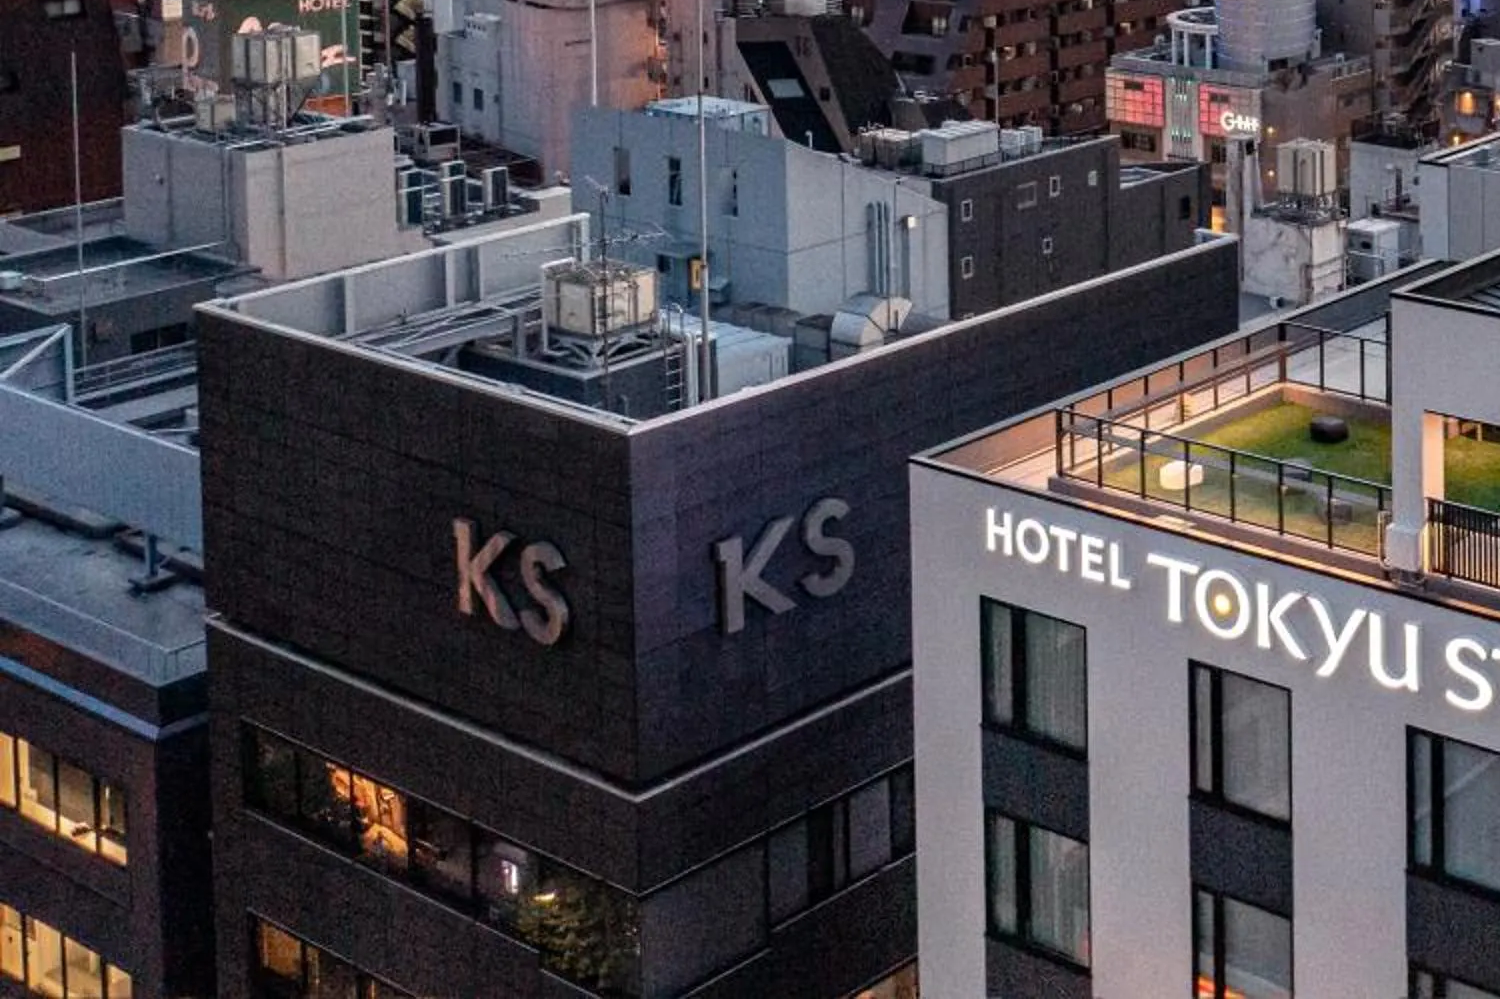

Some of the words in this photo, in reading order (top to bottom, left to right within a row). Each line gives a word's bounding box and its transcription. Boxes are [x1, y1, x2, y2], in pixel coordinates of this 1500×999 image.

[453, 517, 569, 647] KS
[713, 497, 857, 635] KS
[985, 507, 1132, 591] HOTEL
[1147, 552, 1420, 694] TOKYU
